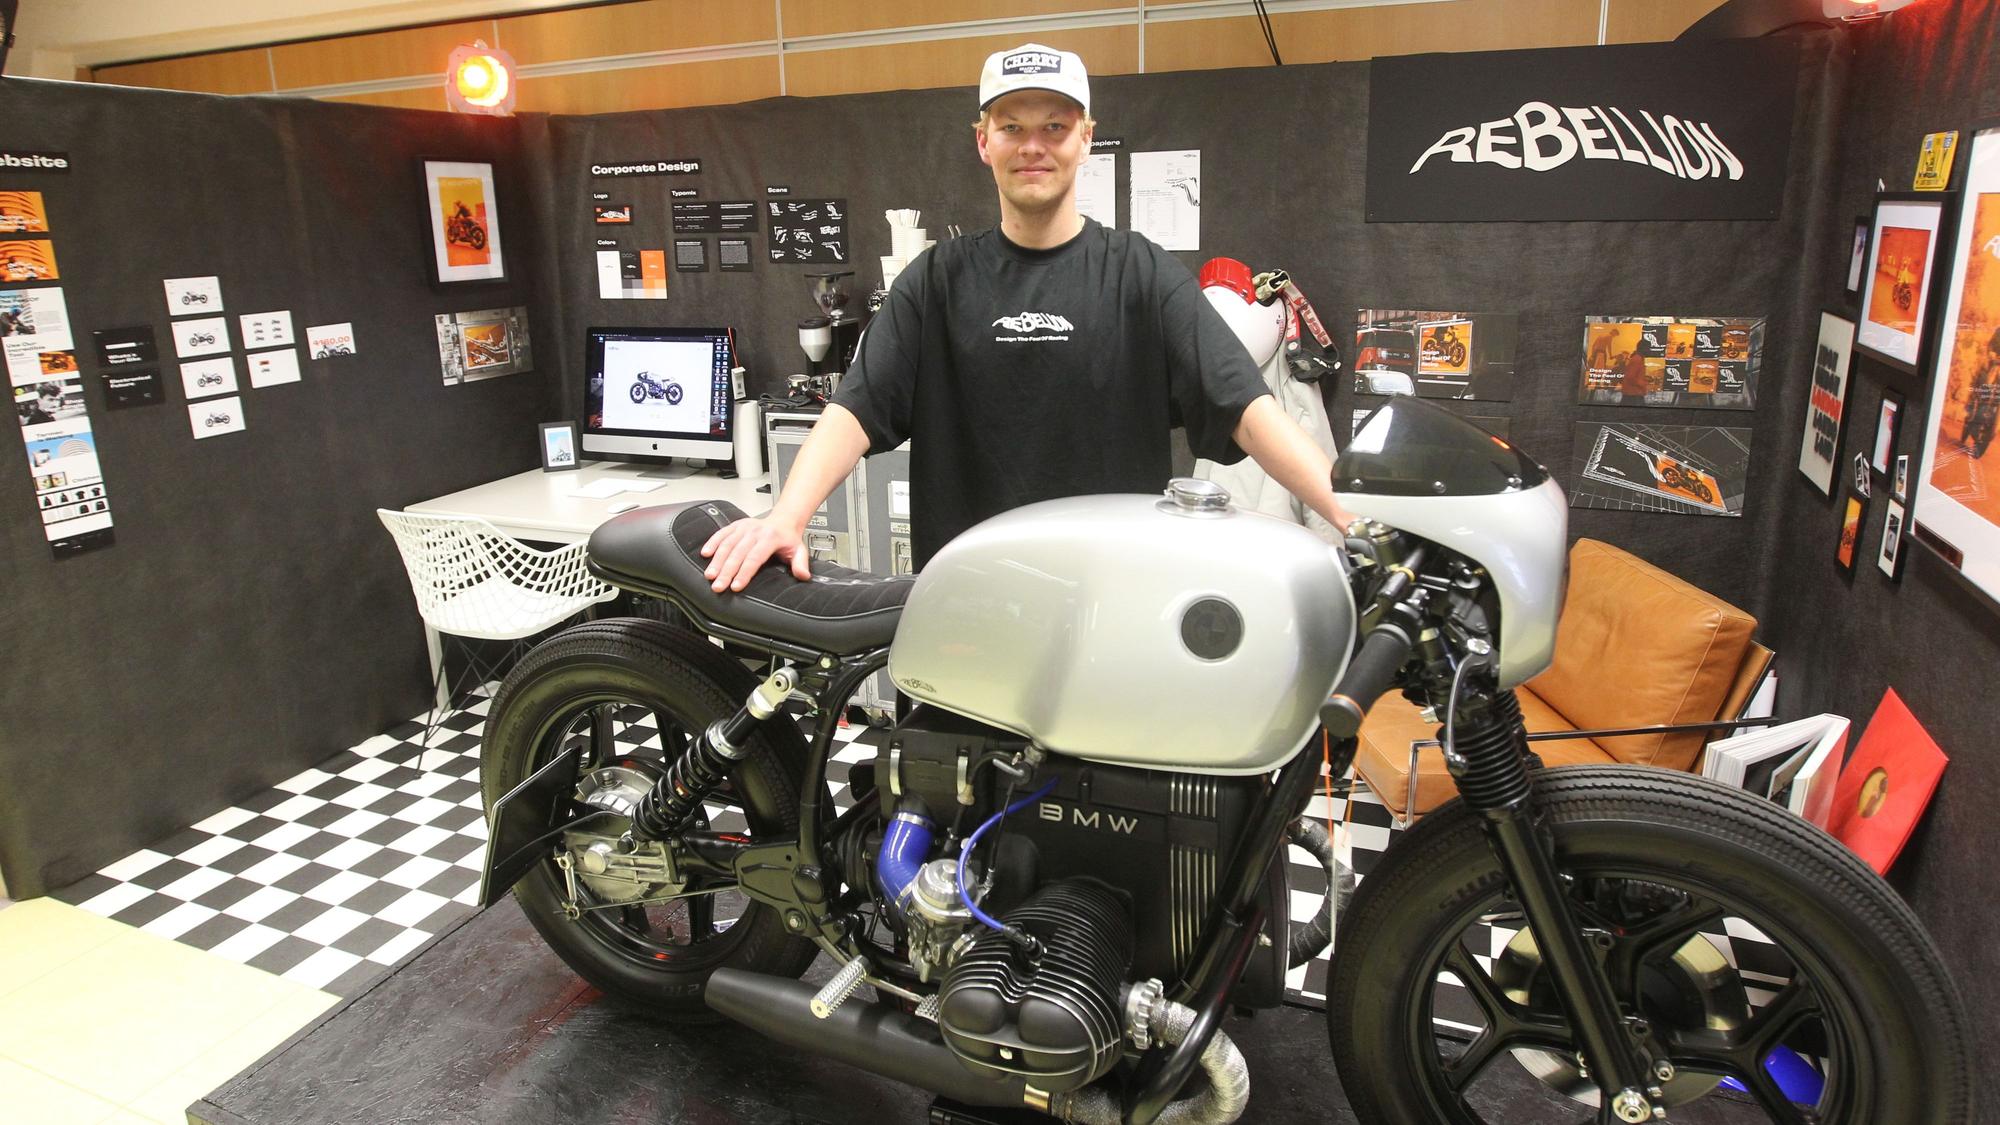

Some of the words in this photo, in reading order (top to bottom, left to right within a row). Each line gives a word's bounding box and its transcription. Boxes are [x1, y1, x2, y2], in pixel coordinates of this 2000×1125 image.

[1004, 53, 1060, 70] CHERRY
[1409, 101, 1744, 181] REBELLION
[591, 164, 657, 176] Corporate
[657, 162, 699, 173] Design
[991, 311, 1074, 333] REBELLION
[1039, 802, 1138, 834] BMW
[1439, 869, 1504, 910] SHIN
